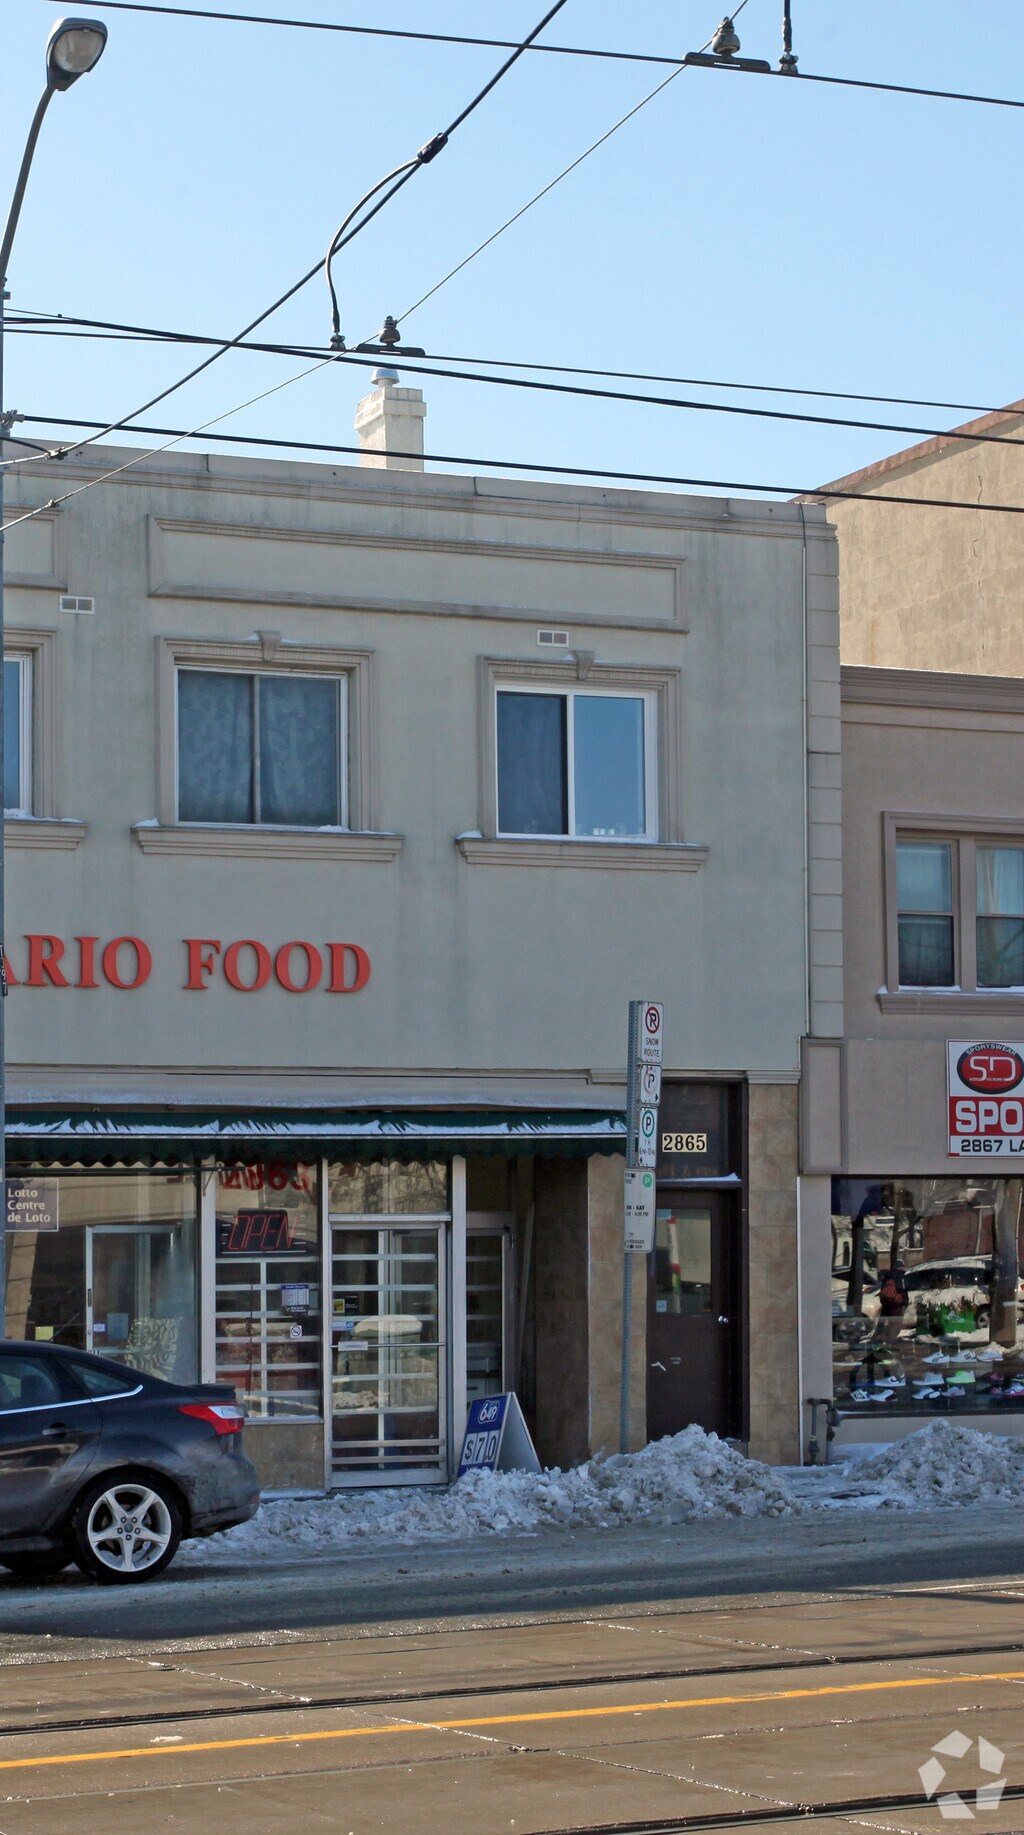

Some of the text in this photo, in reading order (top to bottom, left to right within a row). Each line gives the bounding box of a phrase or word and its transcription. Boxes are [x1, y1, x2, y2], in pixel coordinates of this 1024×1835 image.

[182, 939, 371, 994] FOOD
[645, 1037, 659, 1046] SNOW
[644, 1048, 660, 1057] ROUTE
[965, 1042, 1017, 1056] SPORTSWEAR
[956, 1100, 1024, 1133] SPO
[663, 1135, 706, 1151] 2865
[961, 1139, 1003, 1153] 2867
[7, 1187, 38, 1198] Lotto
[7, 1200, 45, 1210] Centre
[7, 1212, 51, 1222] de Loto
[228, 1215, 299, 1250] OPEN
